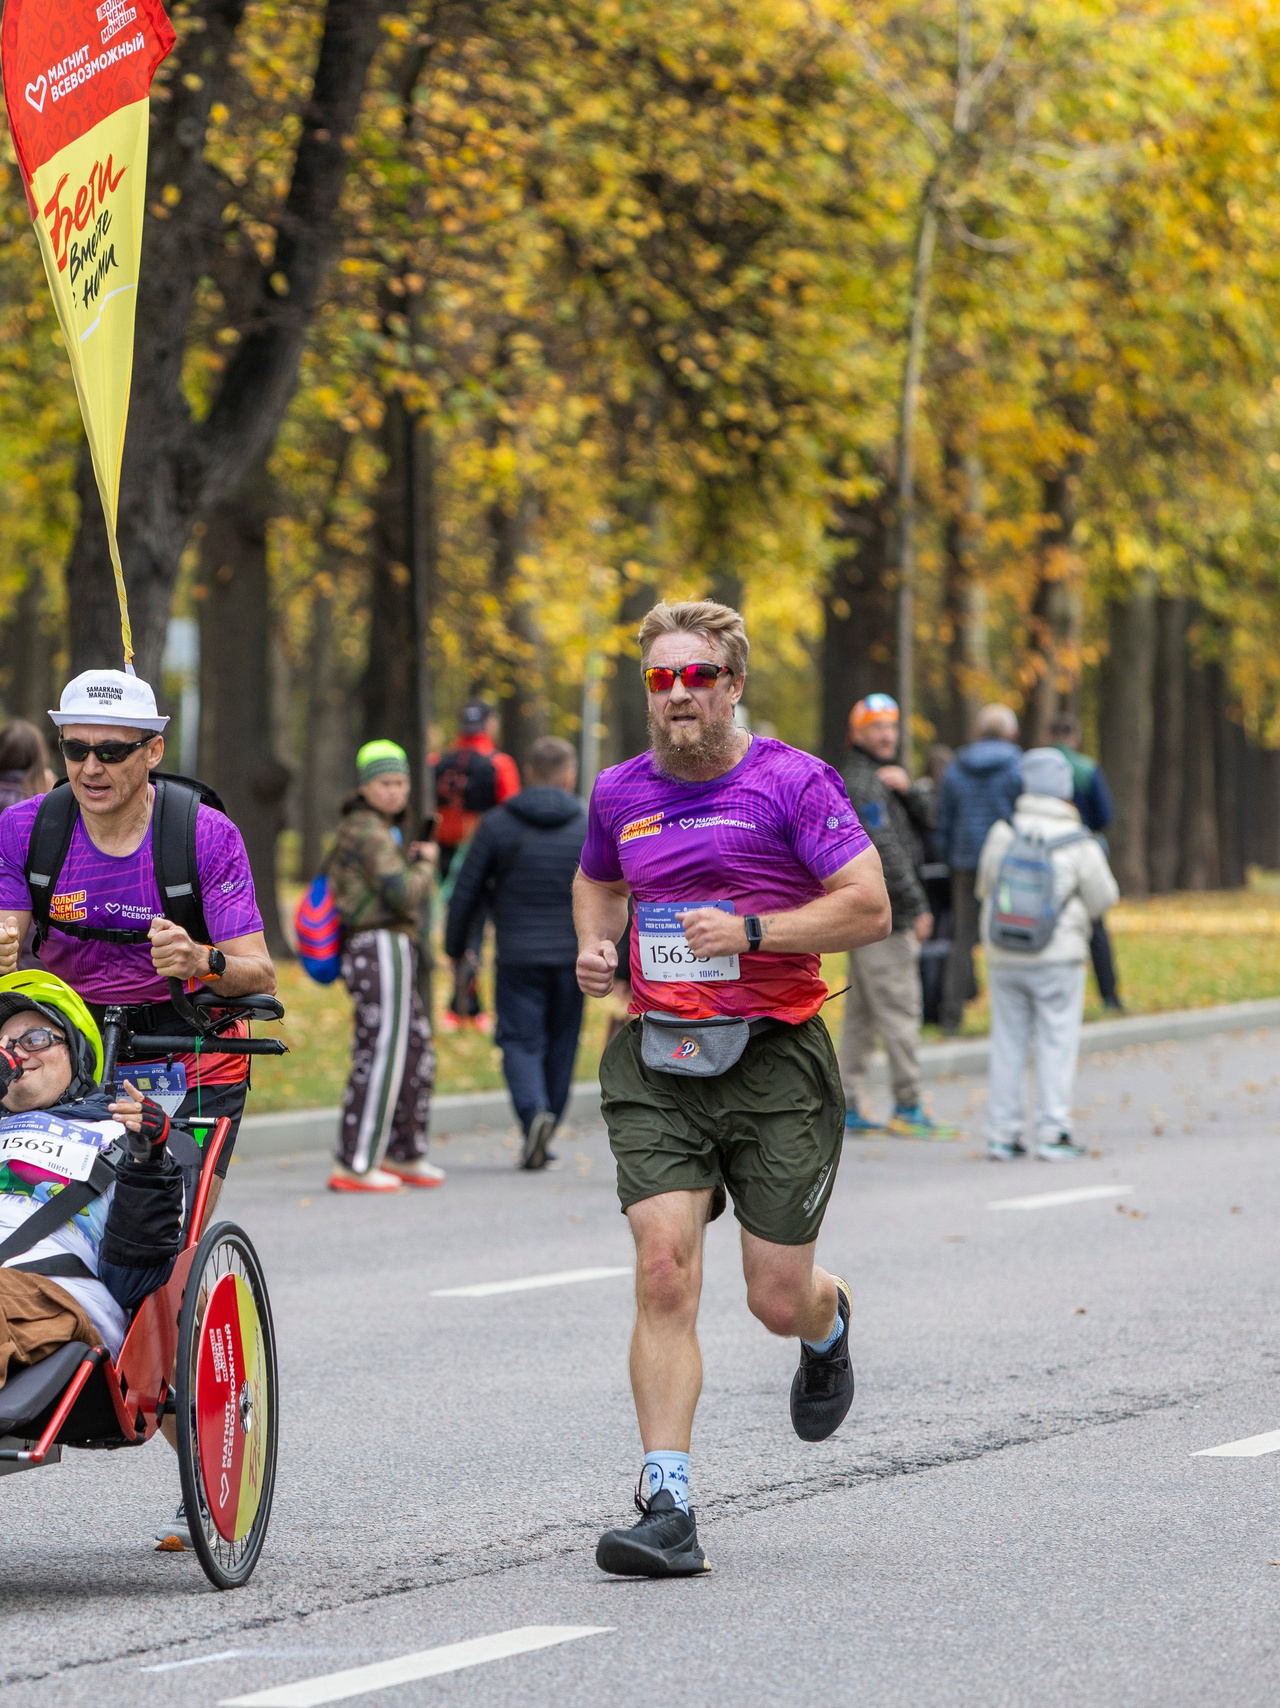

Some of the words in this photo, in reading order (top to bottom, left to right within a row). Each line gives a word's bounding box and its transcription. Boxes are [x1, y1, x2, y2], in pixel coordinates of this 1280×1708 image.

[100, 0, 125, 17] БОЛЬ
[108, 5, 124, 21] ЧЕМ
[102, 10, 135, 42] МОЖЕШЬ
[48, 45, 89, 84] МАГНИТ
[50, 32, 145, 102] ВСЕВОЗМОЖНЫЙ
[86, 686, 123, 695] SAMARKAND
[88, 692, 122, 700] MARATHON
[620, 824, 660, 842] МОЖЕШЬ
[49, 911, 85, 921] МОЖЕШЬ
[55, 904, 72, 913] ЧЕМ
[122, 904, 152, 913] МАГНИТ
[2, 1137, 65, 1158] 15651
[224, 1323, 236, 1469] ВСЕВОЗМОЖНЫЙ
[222, 1401, 231, 1468] МАГНИТ
